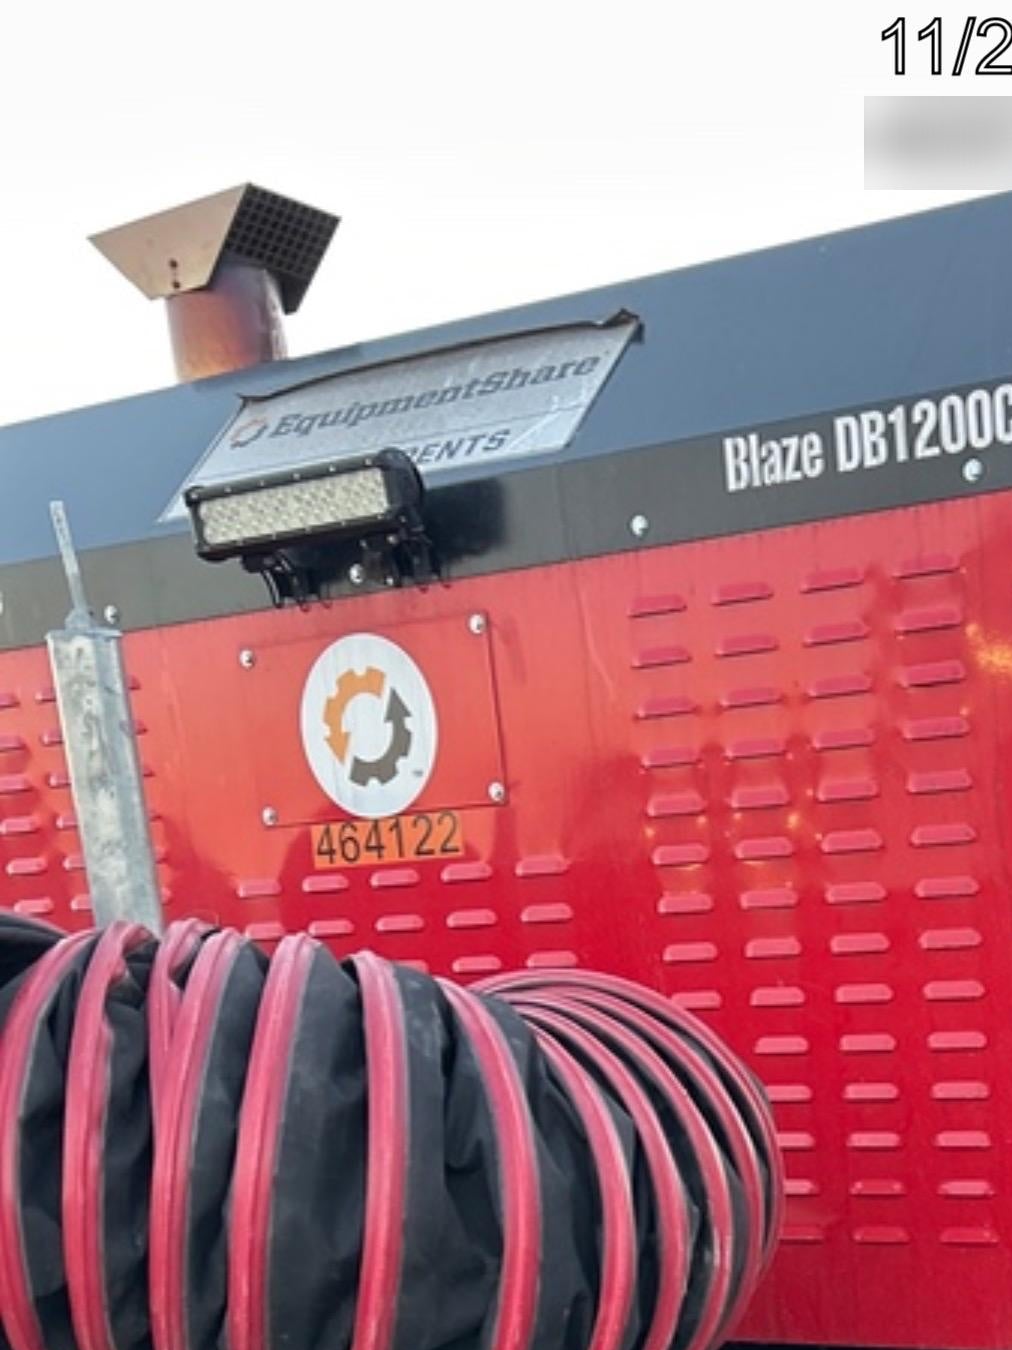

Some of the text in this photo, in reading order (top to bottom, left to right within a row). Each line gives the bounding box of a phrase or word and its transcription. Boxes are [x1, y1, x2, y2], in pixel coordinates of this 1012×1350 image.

[270, 356, 601, 437] EquipmentShare
[723, 431, 826, 493] Blaze
[316, 812, 461, 865] 464122
